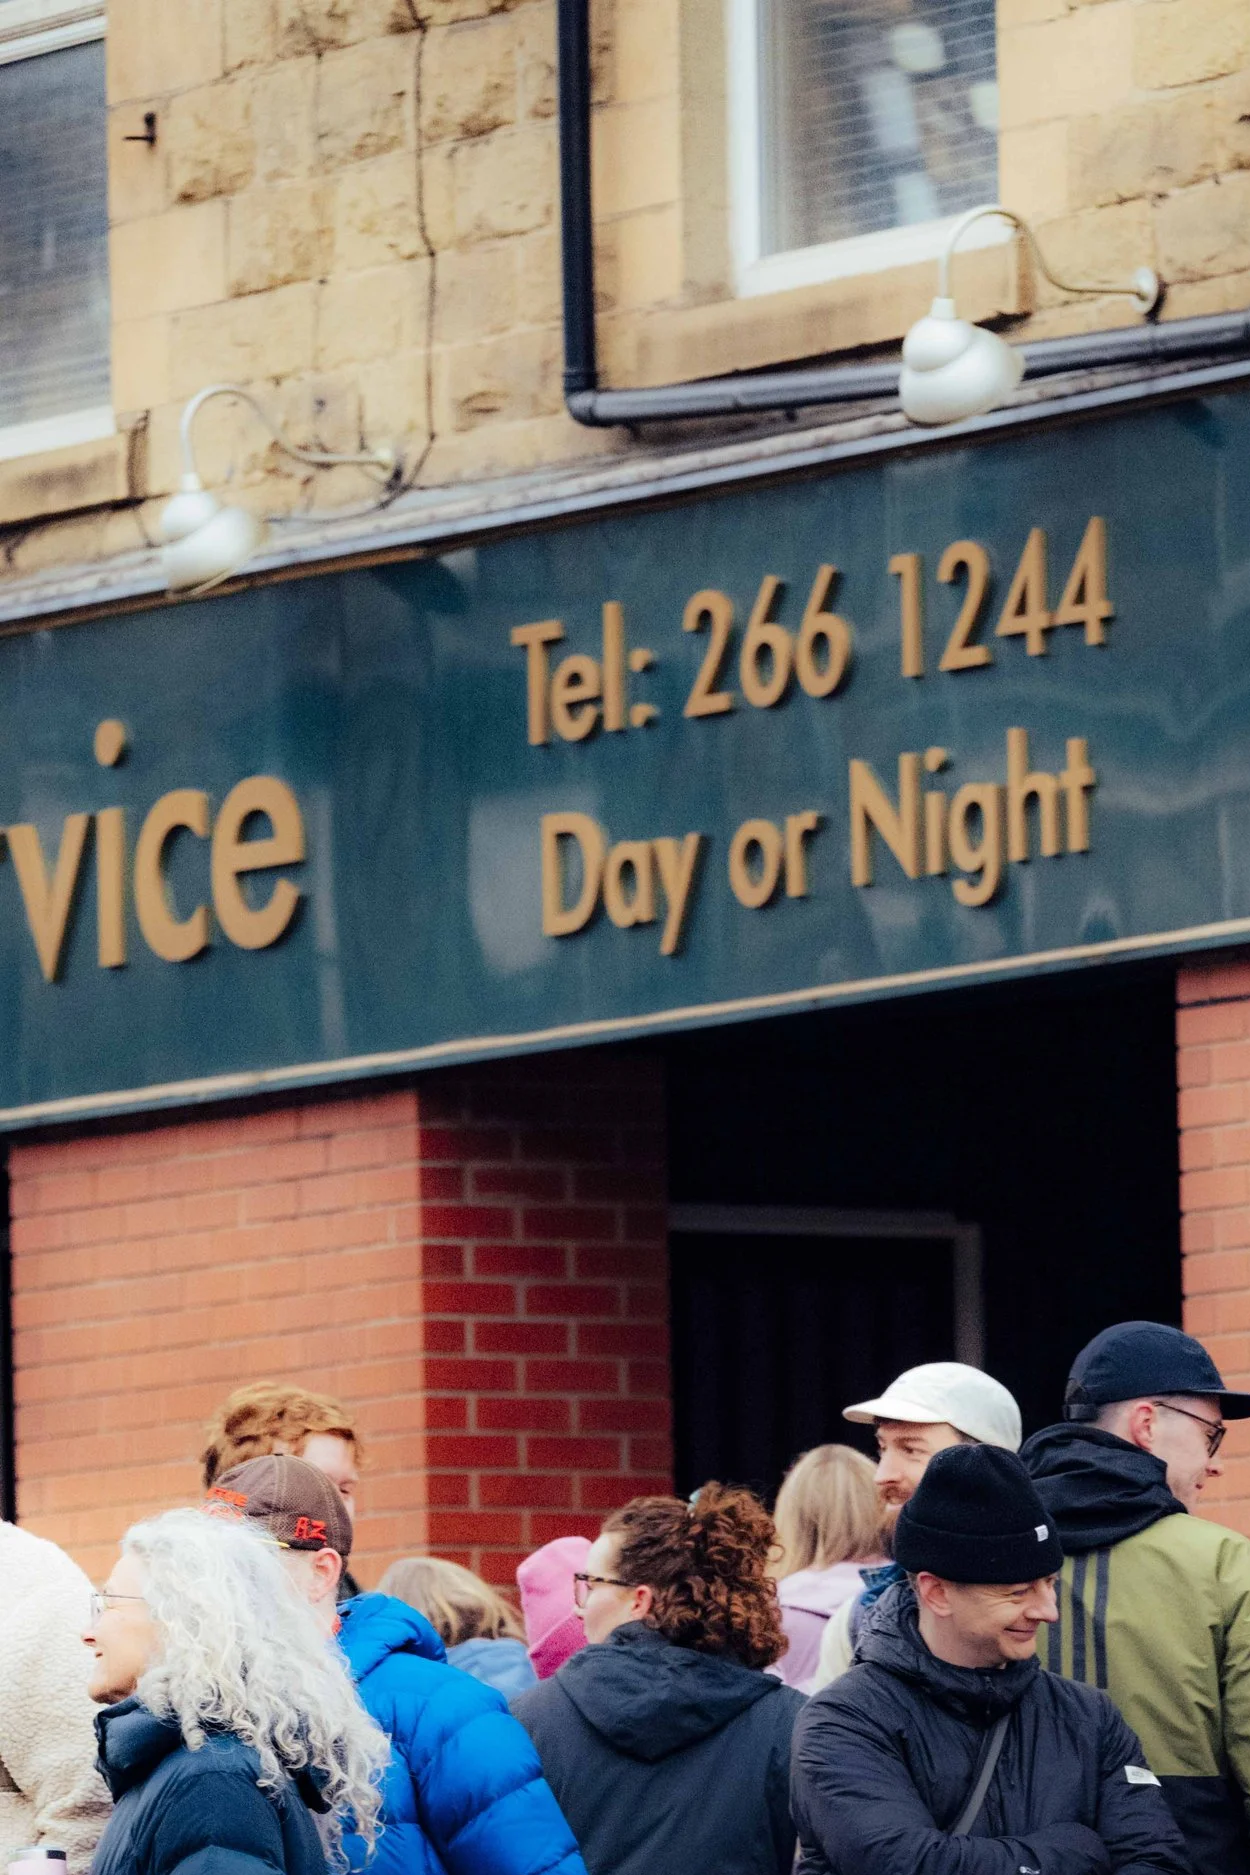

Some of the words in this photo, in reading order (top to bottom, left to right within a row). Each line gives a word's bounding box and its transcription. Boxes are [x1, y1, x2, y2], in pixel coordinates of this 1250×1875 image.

[511, 600, 657, 746] Tel:
[682, 563, 852, 718] 266
[887, 515, 1114, 678] 1244
[540, 811, 701, 956] Day
[728, 809, 819, 909] or
[849, 726, 1096, 907] Night
